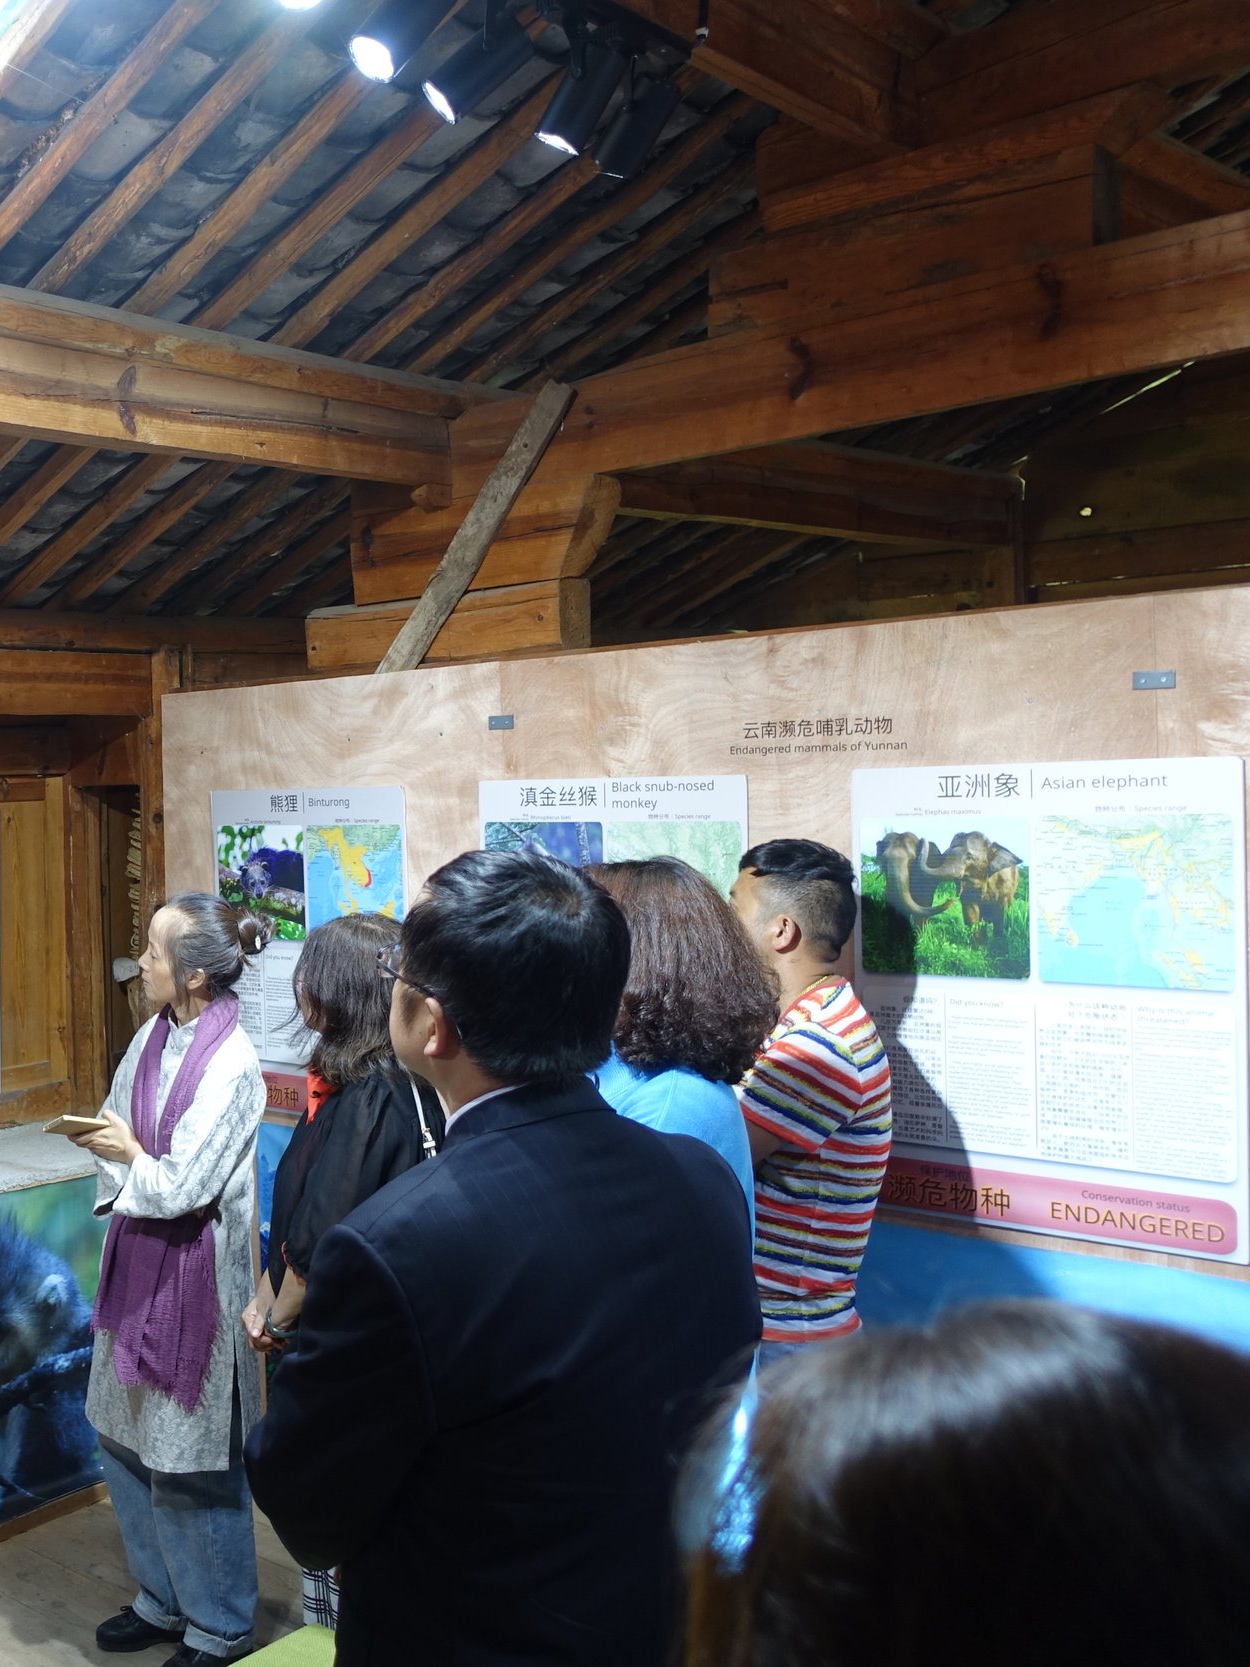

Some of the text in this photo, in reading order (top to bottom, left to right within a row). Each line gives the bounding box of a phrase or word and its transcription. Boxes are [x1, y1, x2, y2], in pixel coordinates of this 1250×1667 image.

[742, 716, 893, 739] 云南濒危哺乳动物
[729, 741, 908, 756] Endangered mammals of Yunnan
[612, 780, 715, 792] Black snub-nosed
[937, 773, 1020, 798] 亚洲象
[1041, 775, 1168, 791] Asian elephant
[270, 794, 298, 812] 熊狸
[308, 798, 350, 808] Binturong
[519, 786, 597, 807] 滇金丝猴
[612, 798, 657, 810] monkey
[1134, 805, 1162, 813] Species
[1137, 1005, 1155, 1015] Why
[1167, 1007, 1182, 1015] this
[1185, 1009, 1215, 1017] animal
[889, 1174, 1010, 1216] 濒危物种
[1081, 1190, 1191, 1213] Conservation status
[1050, 1202, 1226, 1243] ENDANGERED
